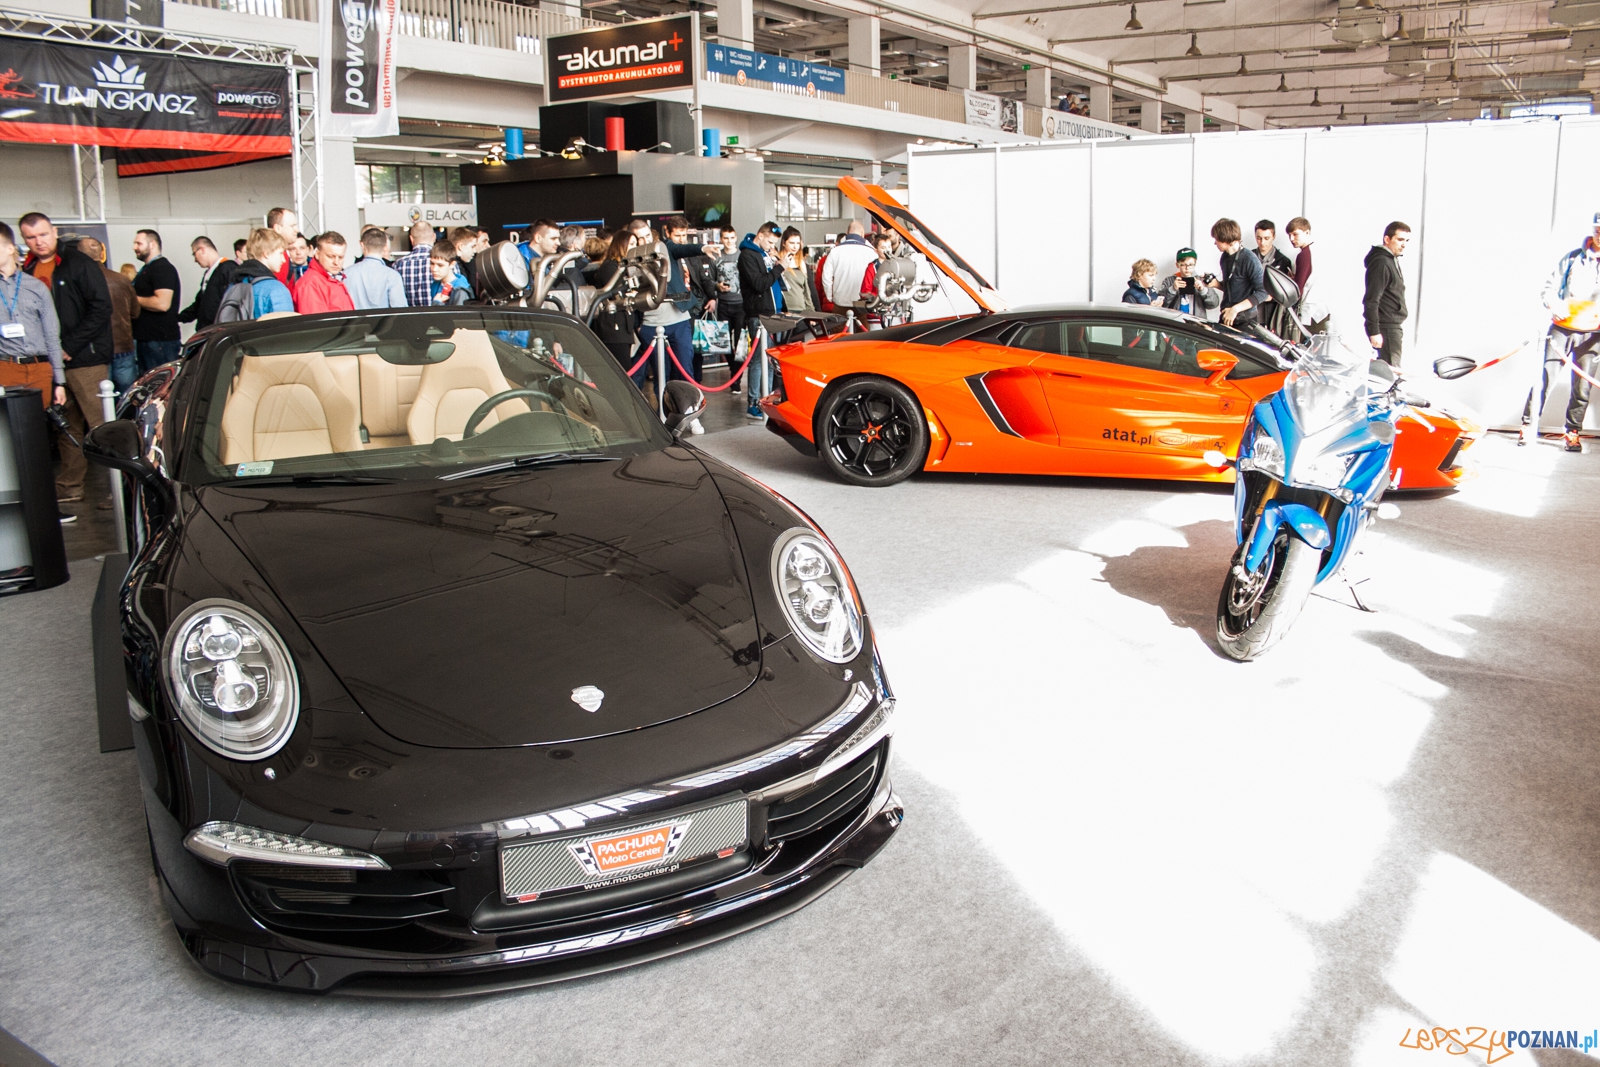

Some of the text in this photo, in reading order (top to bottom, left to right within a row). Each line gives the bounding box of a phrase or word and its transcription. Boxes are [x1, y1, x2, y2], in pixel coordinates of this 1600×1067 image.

[560, 64, 682, 87] DYSTRYBUTOR AKUMULATORÓW
[38, 82, 198, 115] TUNINGKINGZ
[426, 210, 468, 220] BLACK
[1102, 428, 1152, 446] atat.pl
[598, 832, 665, 856] PACHURA
[602, 846, 662, 866] Moto Center
[584, 863, 680, 890] www.motocenter.pl
